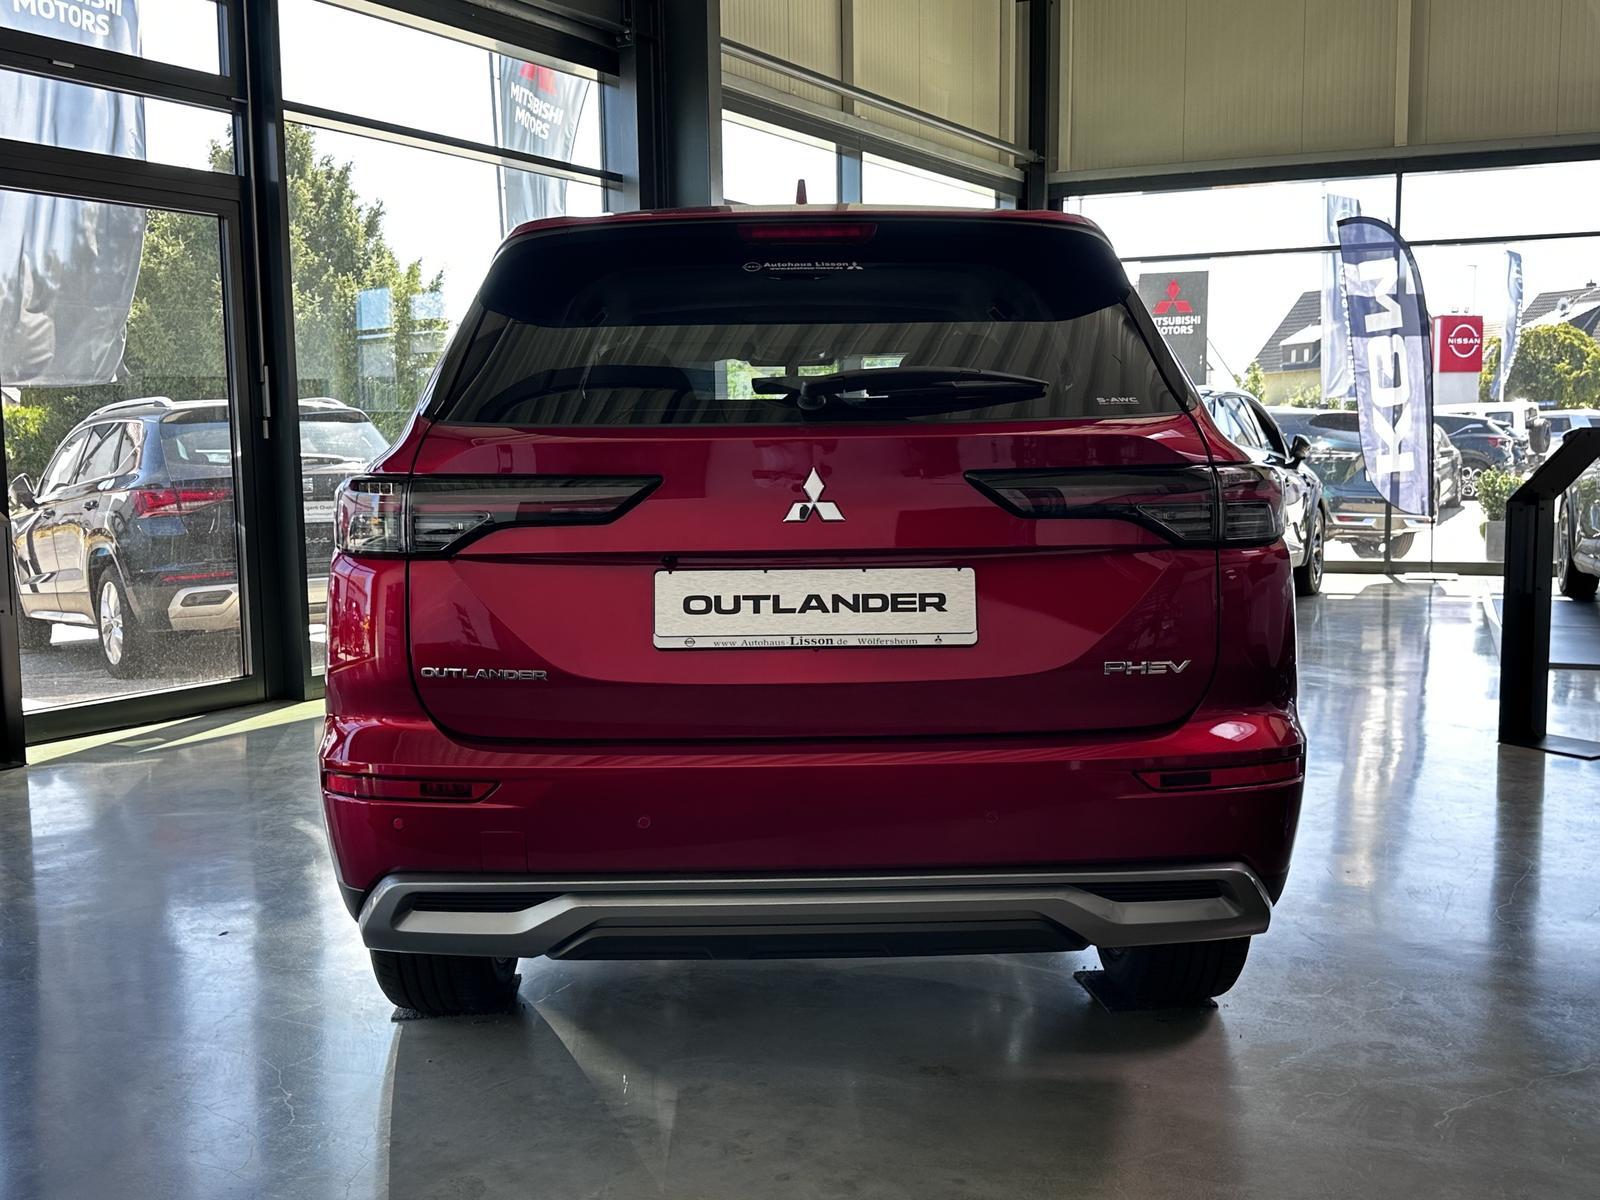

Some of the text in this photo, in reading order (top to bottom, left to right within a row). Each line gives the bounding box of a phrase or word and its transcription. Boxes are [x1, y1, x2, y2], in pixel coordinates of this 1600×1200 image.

[13, 0, 110, 36] MOTORS
[511, 82, 564, 125] MITSBISHI
[515, 106, 550, 140] MOORS
[1158, 325, 1194, 335] OTORS
[683, 593, 948, 615] OUTLANDER
[421, 667, 548, 681] OUTLANDER
[1104, 660, 1191, 675] PHEV
